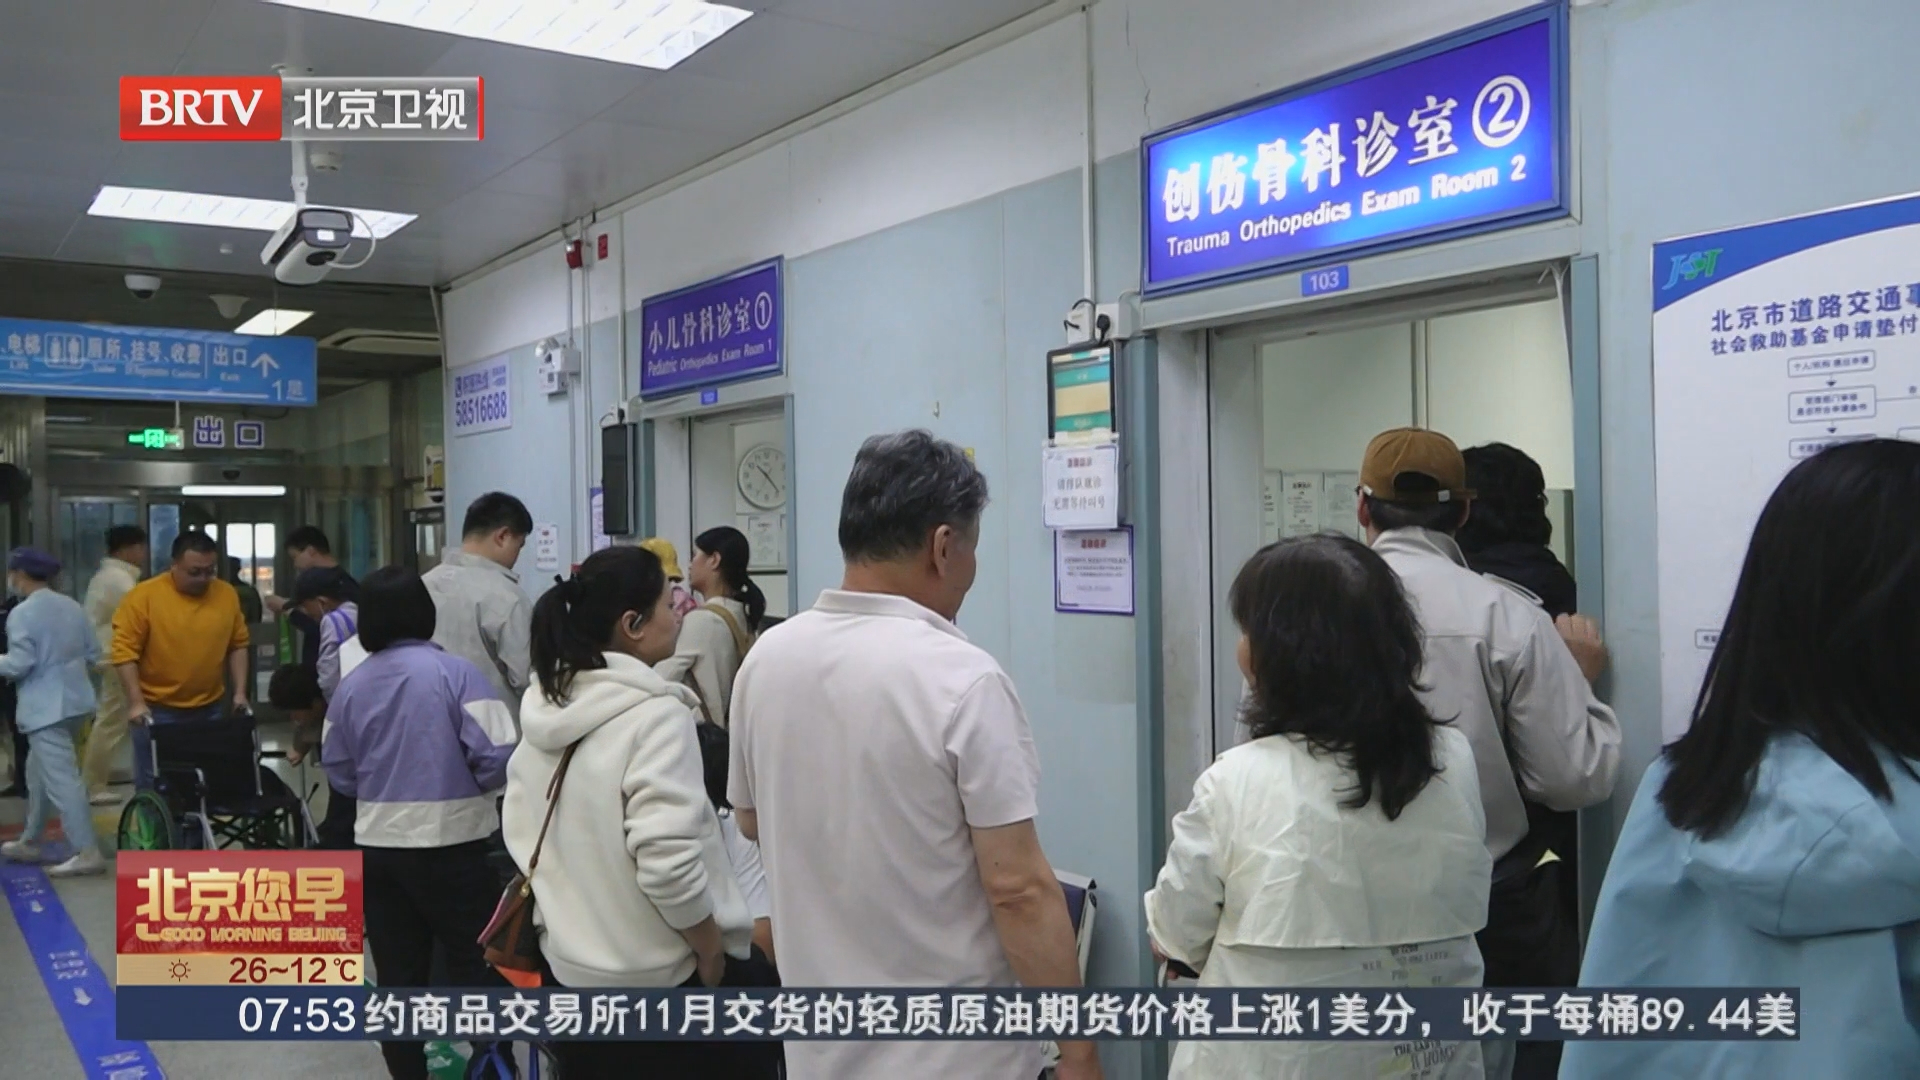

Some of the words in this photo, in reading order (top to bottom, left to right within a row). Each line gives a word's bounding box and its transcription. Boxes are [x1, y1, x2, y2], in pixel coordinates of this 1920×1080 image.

[1167, 226, 1230, 258] Trauma
[1239, 201, 1352, 242] Orthopedics
[1361, 182, 1420, 216] Exam
[1431, 160, 1499, 198] Room
[1511, 155, 1527, 181] 2
[1310, 271, 1339, 292] 103
[1711, 313, 1919, 356] 社会救助基金申请垫付
[213, 345, 248, 366] 出口
[722, 347, 741, 363] Exam
[456, 390, 508, 428] 58516688
[194, 415, 266, 450] 出口
